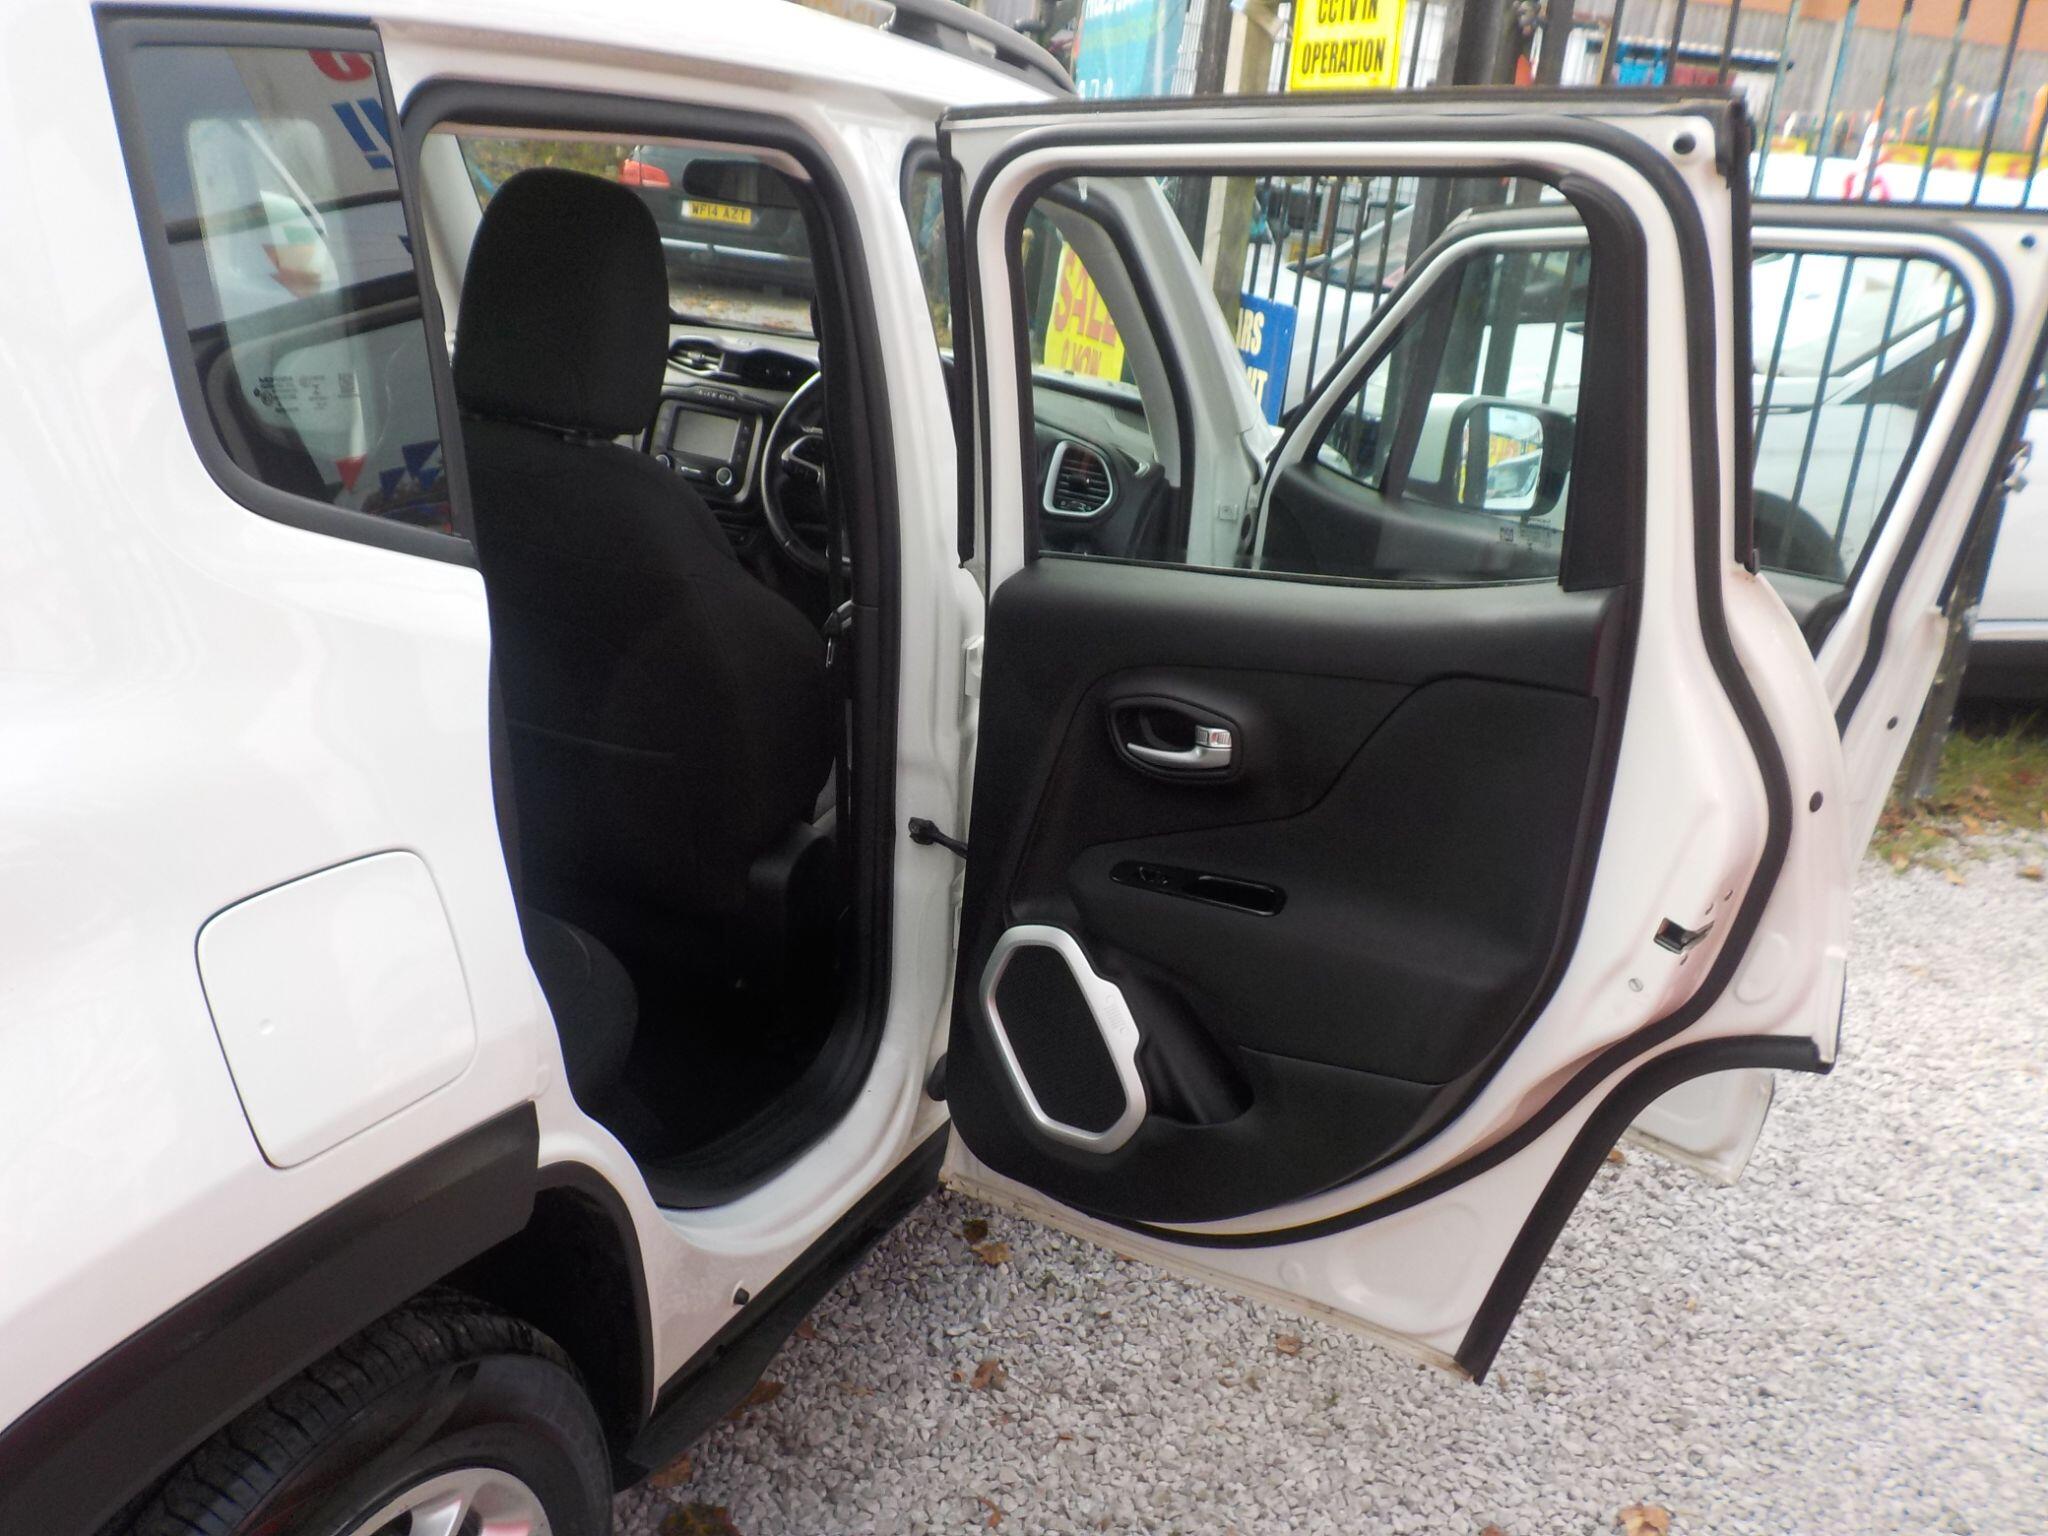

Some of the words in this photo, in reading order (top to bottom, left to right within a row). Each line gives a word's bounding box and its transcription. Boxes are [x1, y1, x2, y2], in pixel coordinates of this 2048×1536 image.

[1317, 0, 1361, 24] CCTV
[1361, 0, 1379, 20] IN
[1301, 38, 1386, 75] OPERATION
